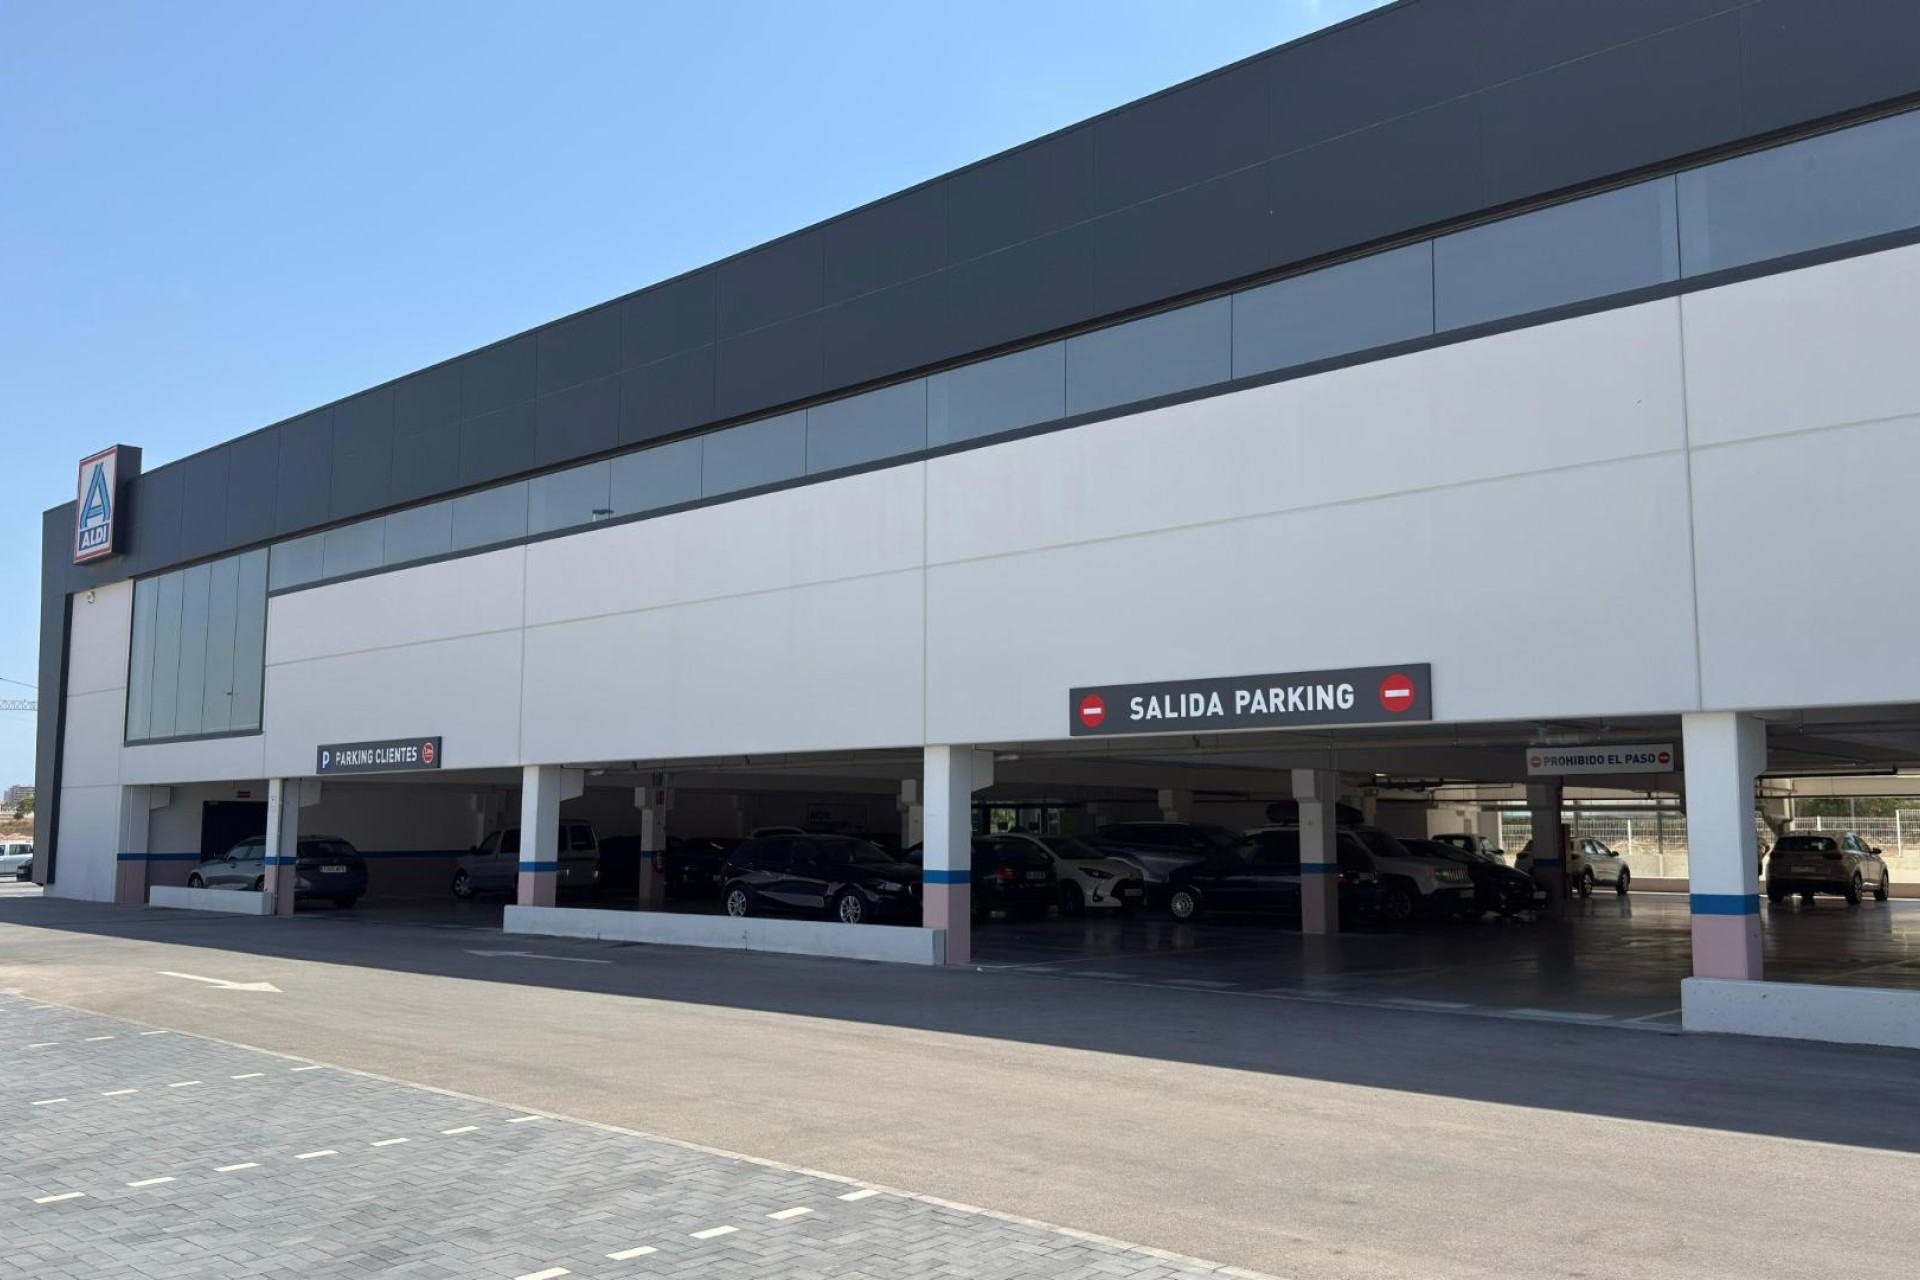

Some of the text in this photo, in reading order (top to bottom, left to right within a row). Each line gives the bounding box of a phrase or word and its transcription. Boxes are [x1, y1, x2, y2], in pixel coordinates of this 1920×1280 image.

[81, 525, 107, 549] ALDI
[1130, 684, 1355, 720] SALIDA PARKING
[322, 751, 330, 768] P
[335, 750, 373, 766] PARKING
[375, 746, 418, 764] CLIENTES
[1543, 753, 1655, 766] PROHIBIDO EL PASO
